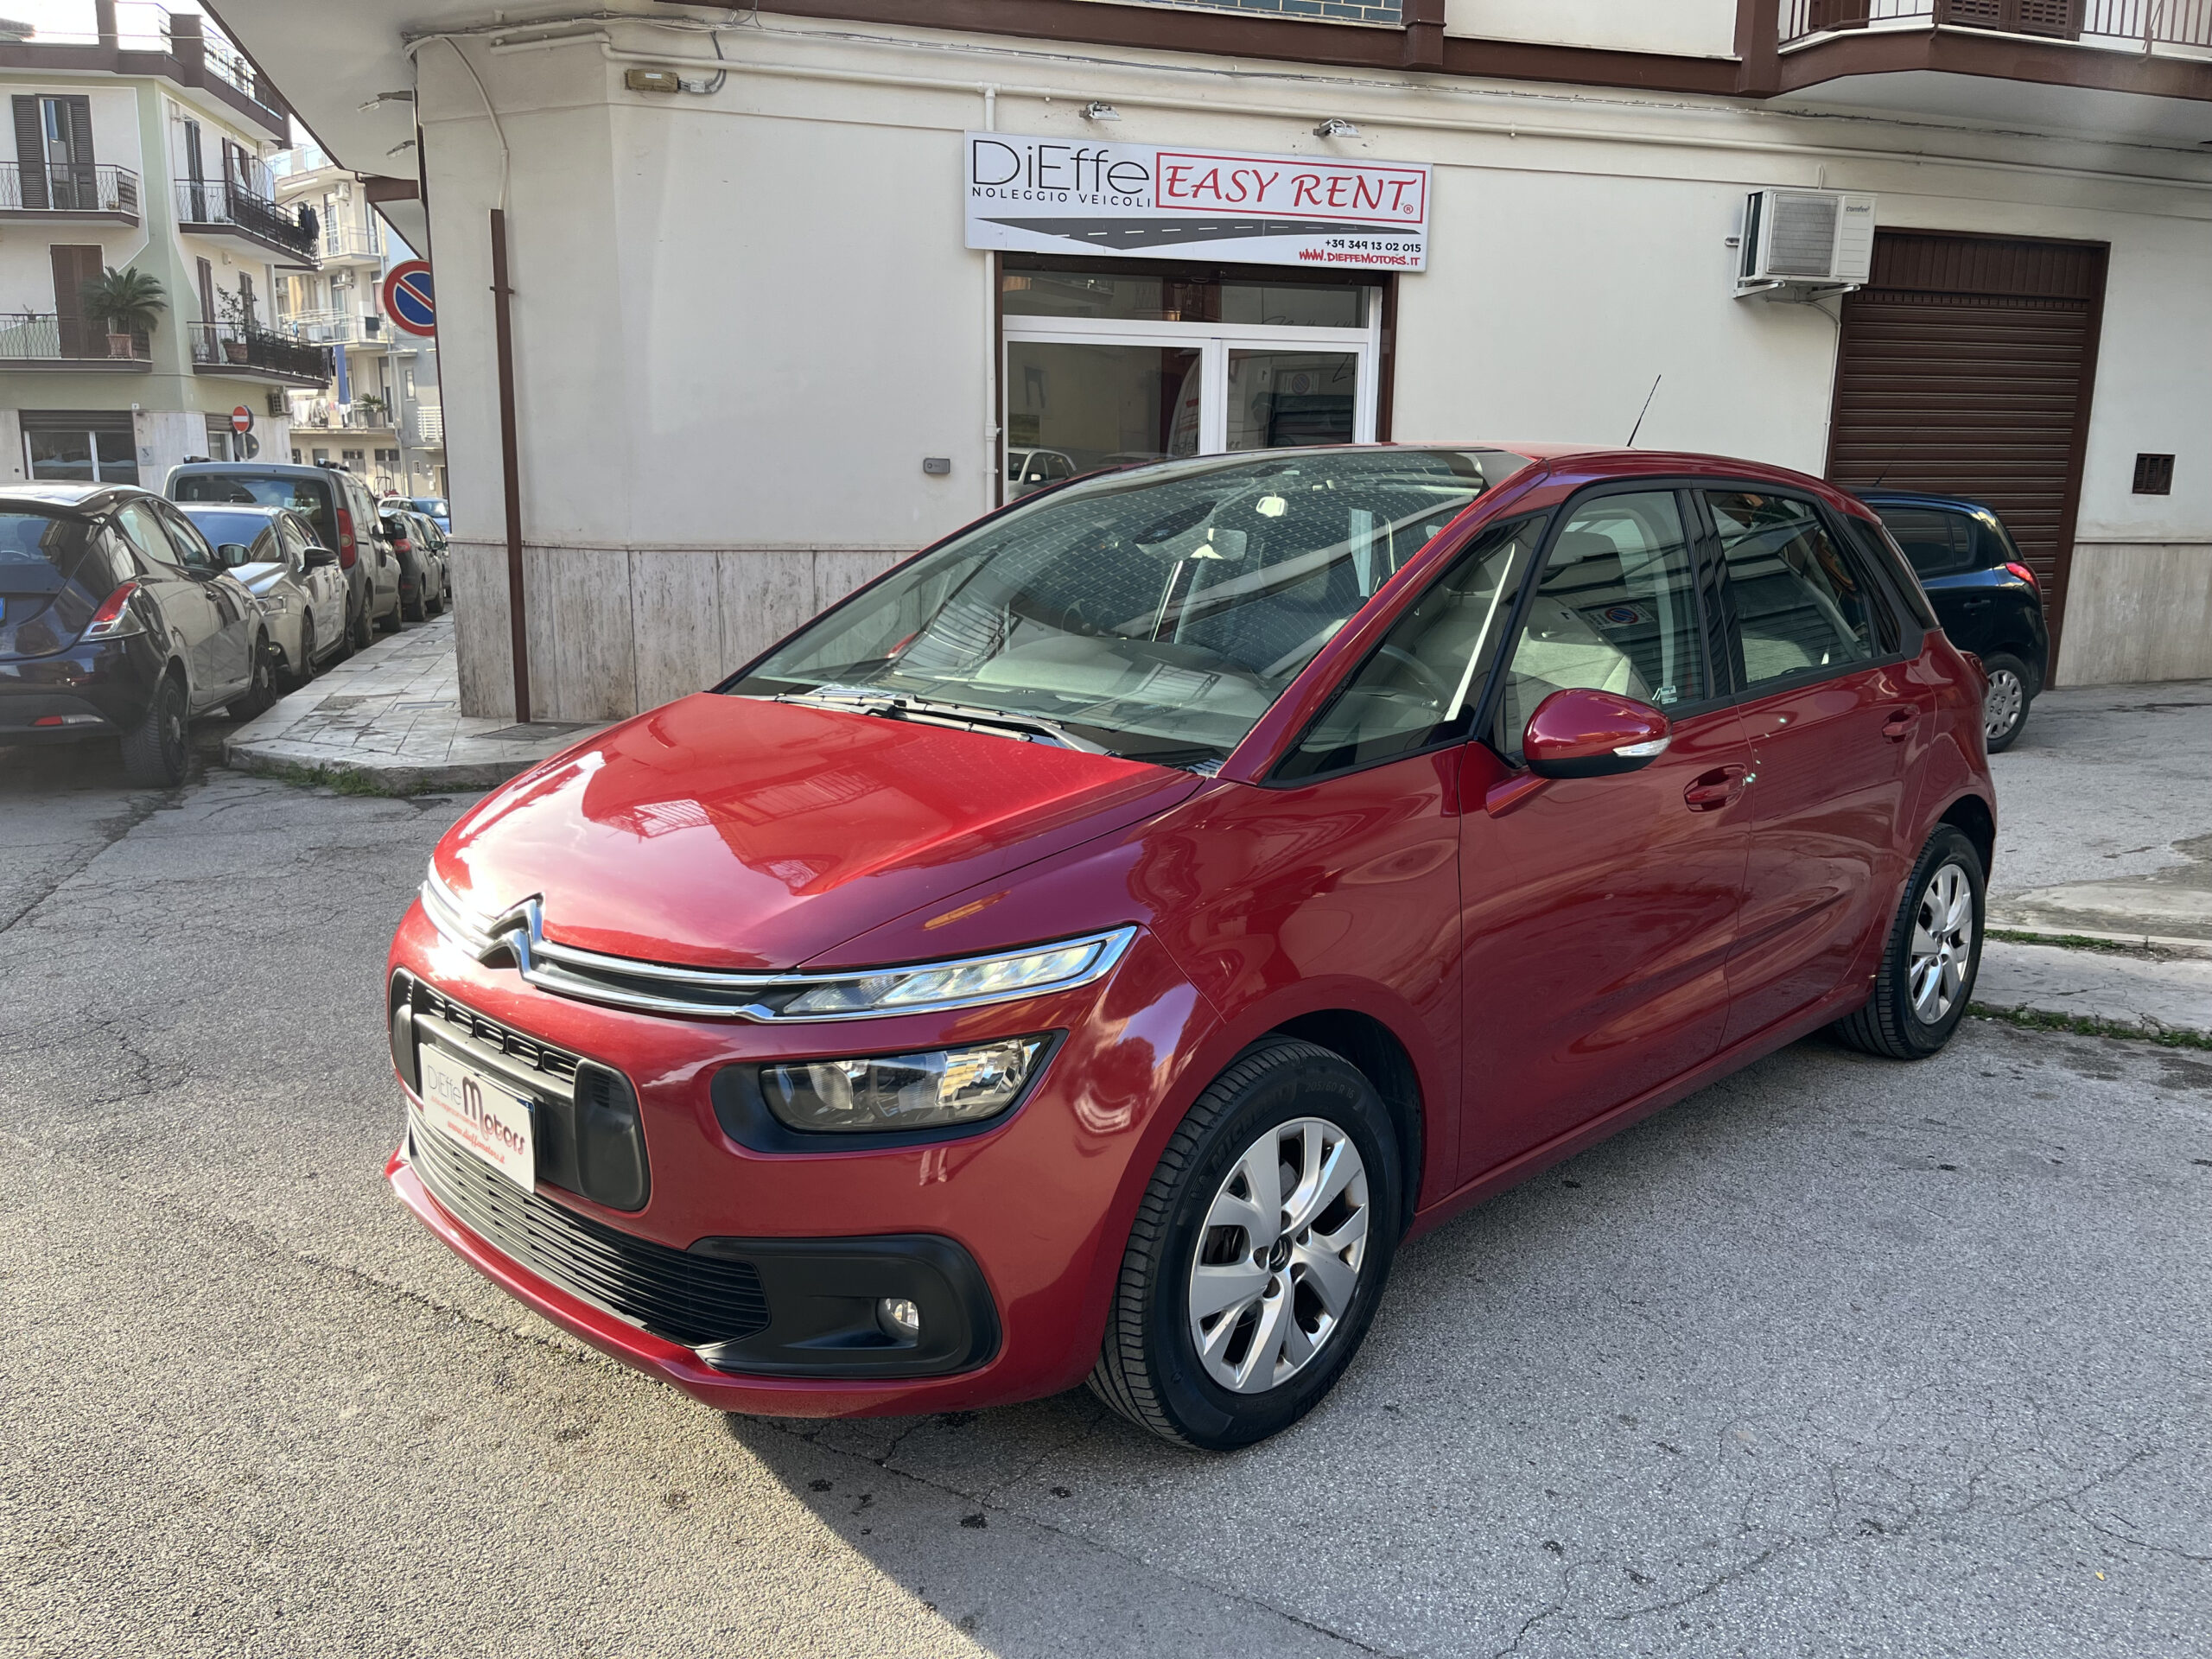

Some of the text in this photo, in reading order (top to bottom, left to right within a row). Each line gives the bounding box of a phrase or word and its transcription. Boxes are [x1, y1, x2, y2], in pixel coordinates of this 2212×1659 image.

[972, 139, 1150, 194] DiEffe
[972, 187, 1151, 207] NOLEGGIO VEICOLI
[1165, 165, 1280, 203] EASY
[1291, 174, 1417, 211] RENT
[1325, 239, 1421, 252] +39 349 13 02 015
